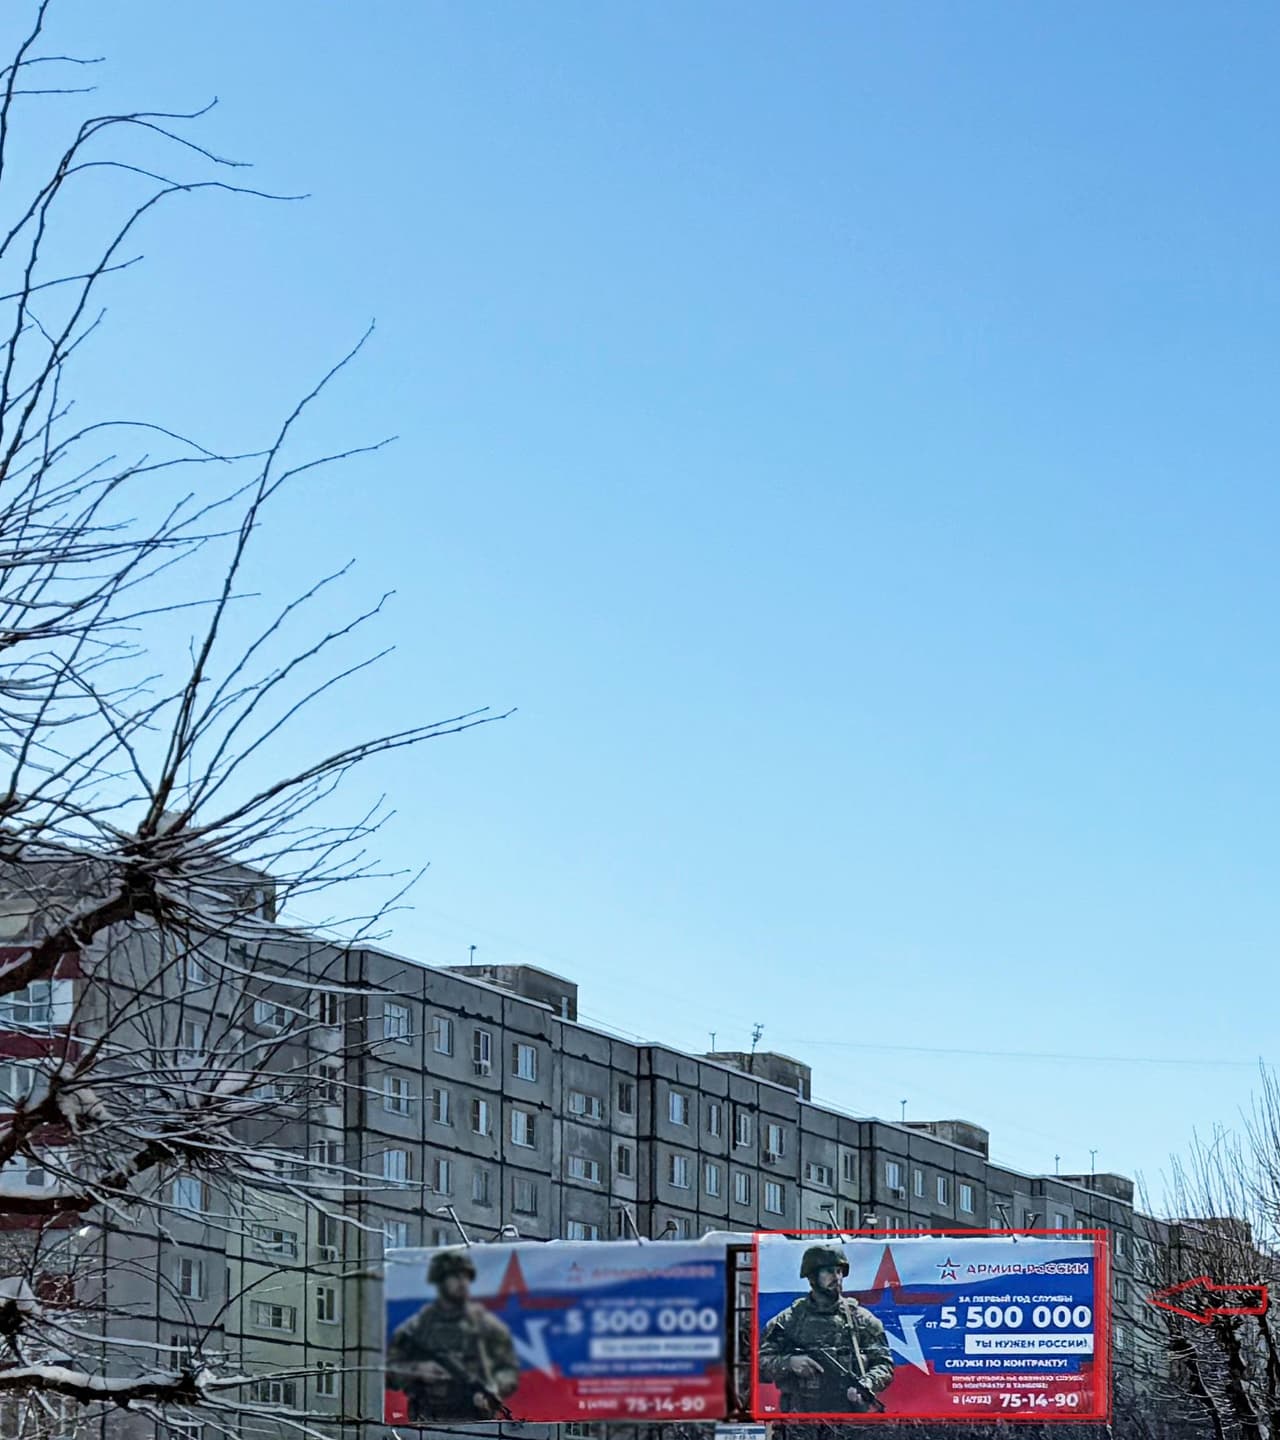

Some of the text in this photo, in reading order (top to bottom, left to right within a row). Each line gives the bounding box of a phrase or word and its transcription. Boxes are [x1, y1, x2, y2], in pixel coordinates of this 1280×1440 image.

[1012, 1295, 1031, 1304] ГОД
[1032, 1295, 1073, 1303] СЛУЖБЫ
[591, 1308, 649, 1333] 500
[657, 1308, 718, 1332] 000
[939, 1305, 958, 1330] 5
[965, 1305, 1024, 1329] 500
[1032, 1305, 1092, 1329] 000
[975, 1338, 1088, 1349] ТЫ НУЖЕН РОССИИ!
[944, 1358, 1068, 1369] СЛУЖИ ПО КОНТРАКТУ!
[999, 1392, 1079, 1408] 75-14-90
